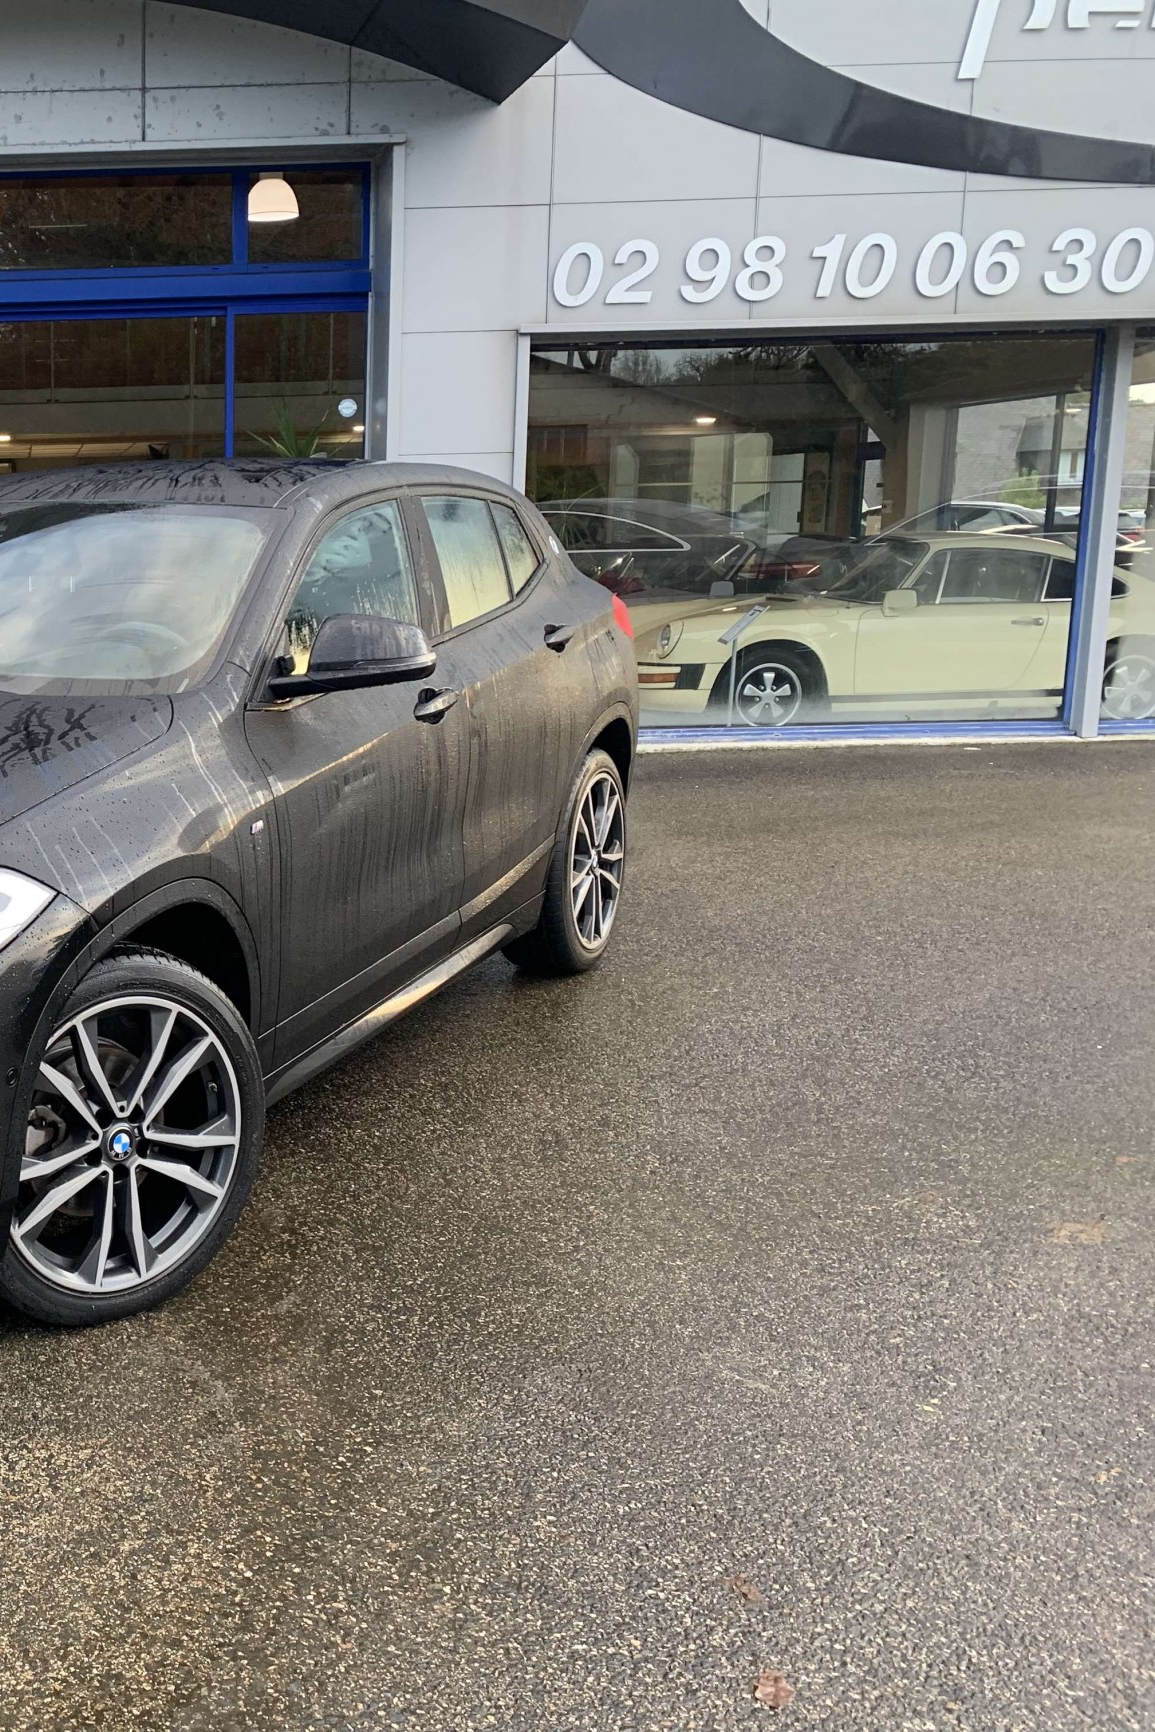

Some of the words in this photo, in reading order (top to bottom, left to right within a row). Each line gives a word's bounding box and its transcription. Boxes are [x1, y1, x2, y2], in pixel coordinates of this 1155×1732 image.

[552, 239, 660, 308] 02
[680, 234, 787, 304] 98
[812, 232, 897, 300] 10
[915, 228, 1026, 298] 06
[1043, 227, 1155, 295] 30
